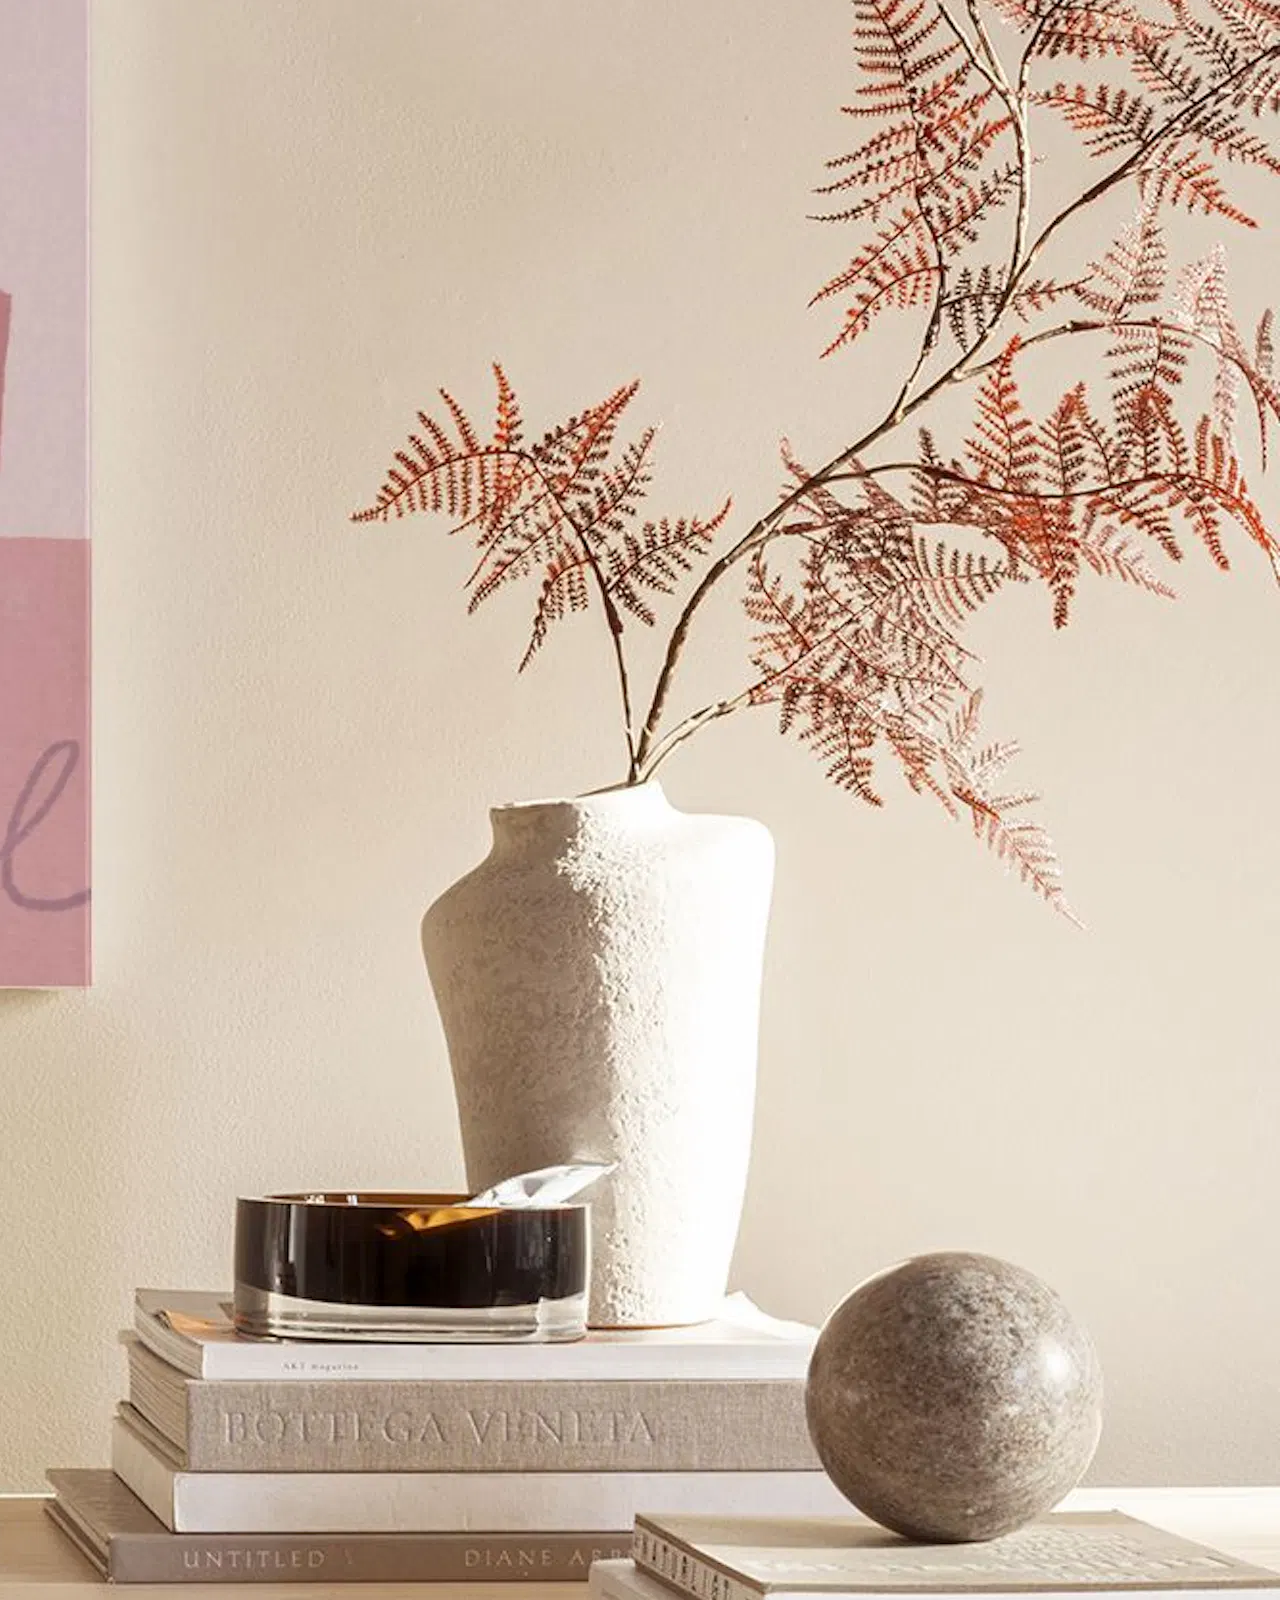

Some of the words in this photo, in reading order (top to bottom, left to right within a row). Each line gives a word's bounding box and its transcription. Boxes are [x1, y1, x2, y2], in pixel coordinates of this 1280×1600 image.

[223, 1410, 446, 1445] BOTTEGA
[466, 1410, 657, 1445] VENETA
[183, 1549, 326, 1569] UNTITLED
[464, 1547, 552, 1568] DIANE
